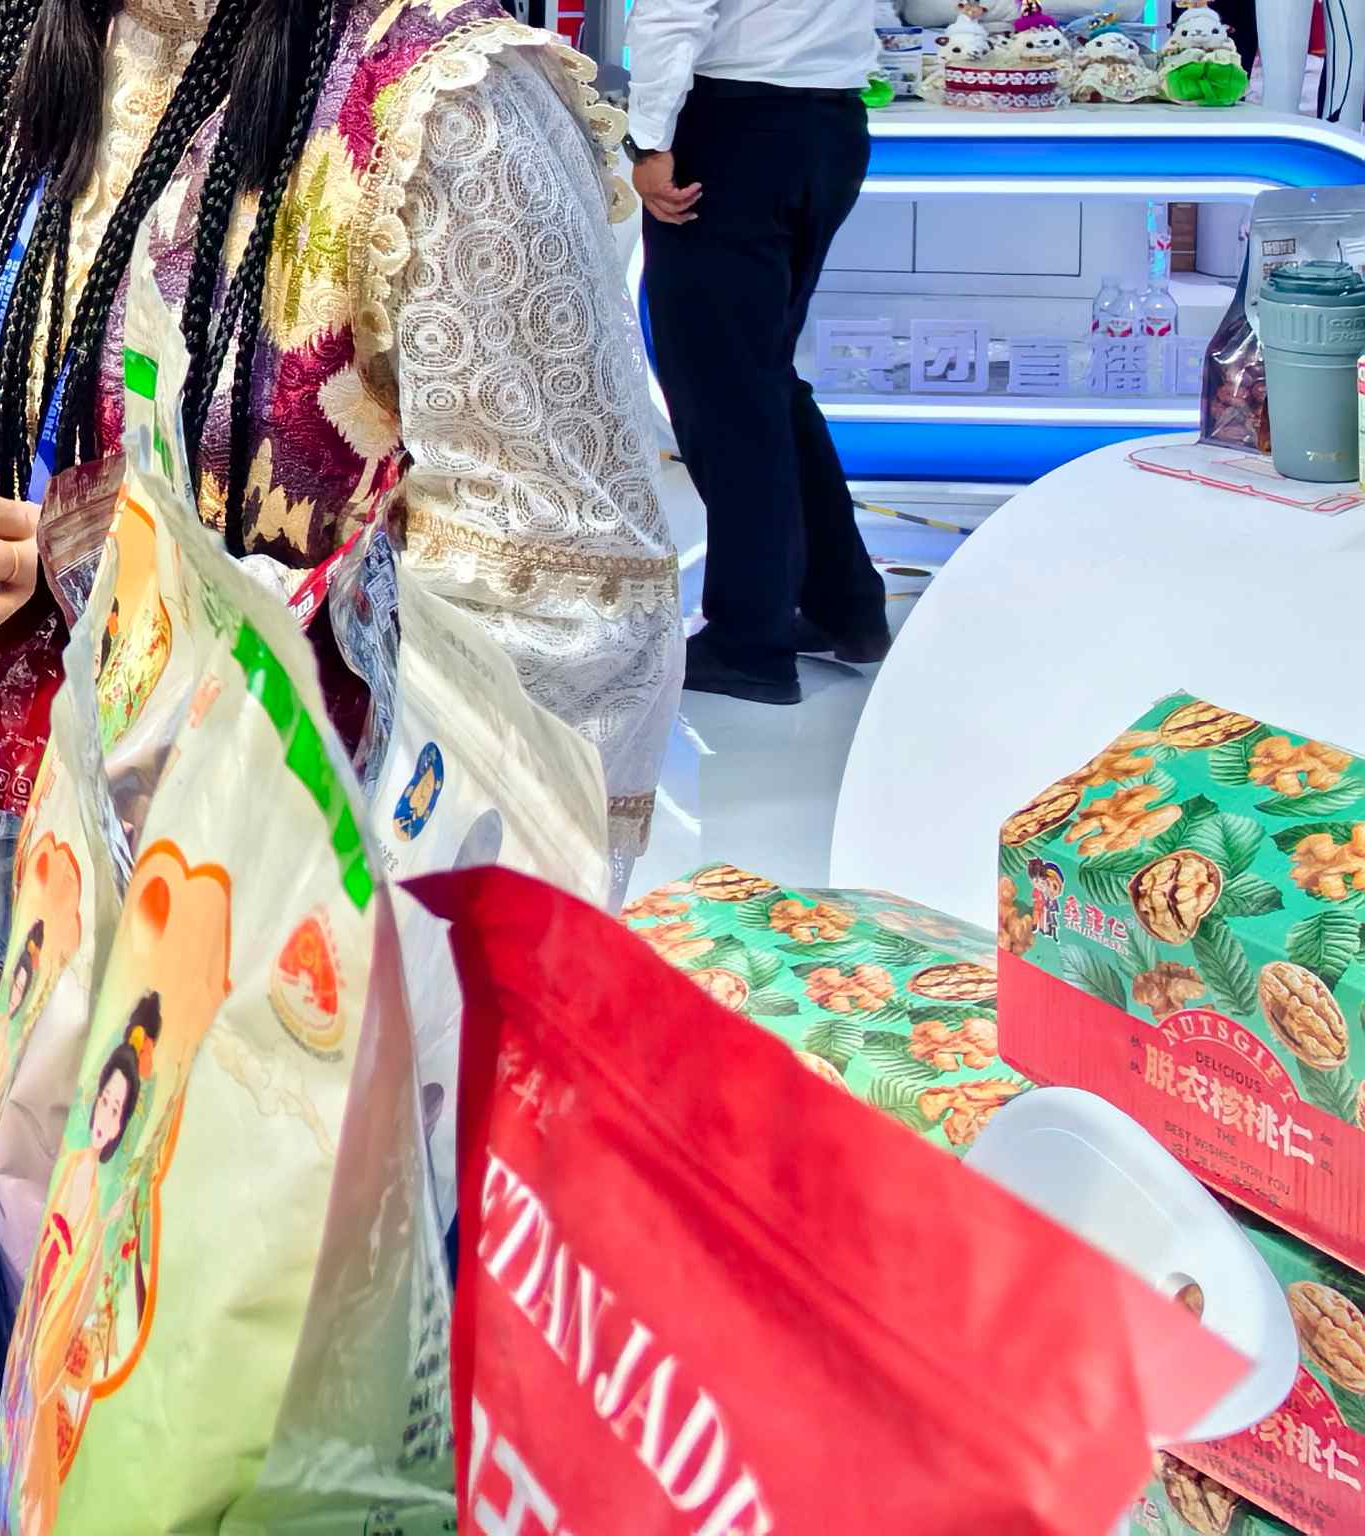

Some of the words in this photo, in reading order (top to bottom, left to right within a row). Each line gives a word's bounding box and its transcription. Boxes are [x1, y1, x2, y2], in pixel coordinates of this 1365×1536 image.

[1145, 1043, 1314, 1165] 脱衣核桃仁
[1195, 1051, 1262, 1094] DELICIOUS
